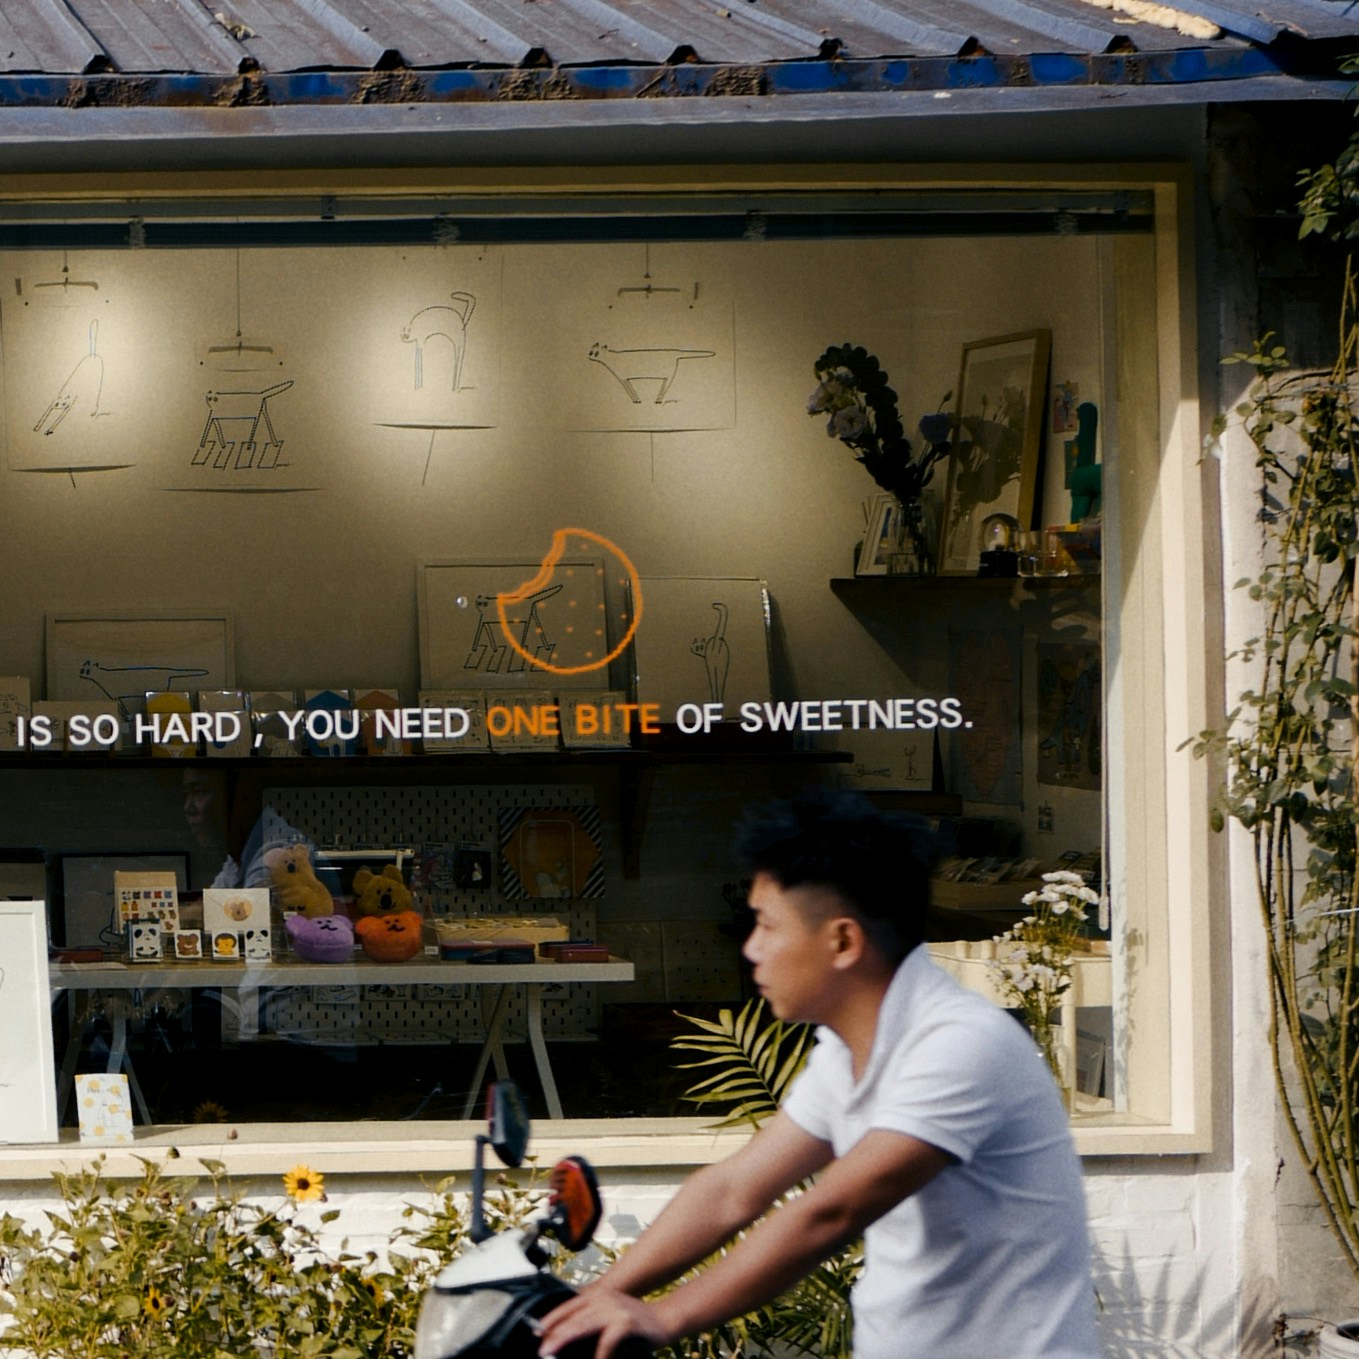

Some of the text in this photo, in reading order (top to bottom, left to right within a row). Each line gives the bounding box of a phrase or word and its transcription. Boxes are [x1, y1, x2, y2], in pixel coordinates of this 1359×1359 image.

[17, 715, 52, 747] IS
[68, 713, 120, 746] SO
[134, 711, 241, 744] HARD
[277, 708, 360, 741] YOU
[375, 706, 470, 740] NEED
[486, 704, 560, 737] ONE
[575, 702, 661, 736] BITE
[676, 702, 725, 734] OF
[739, 697, 974, 733] SWEETNESS.
